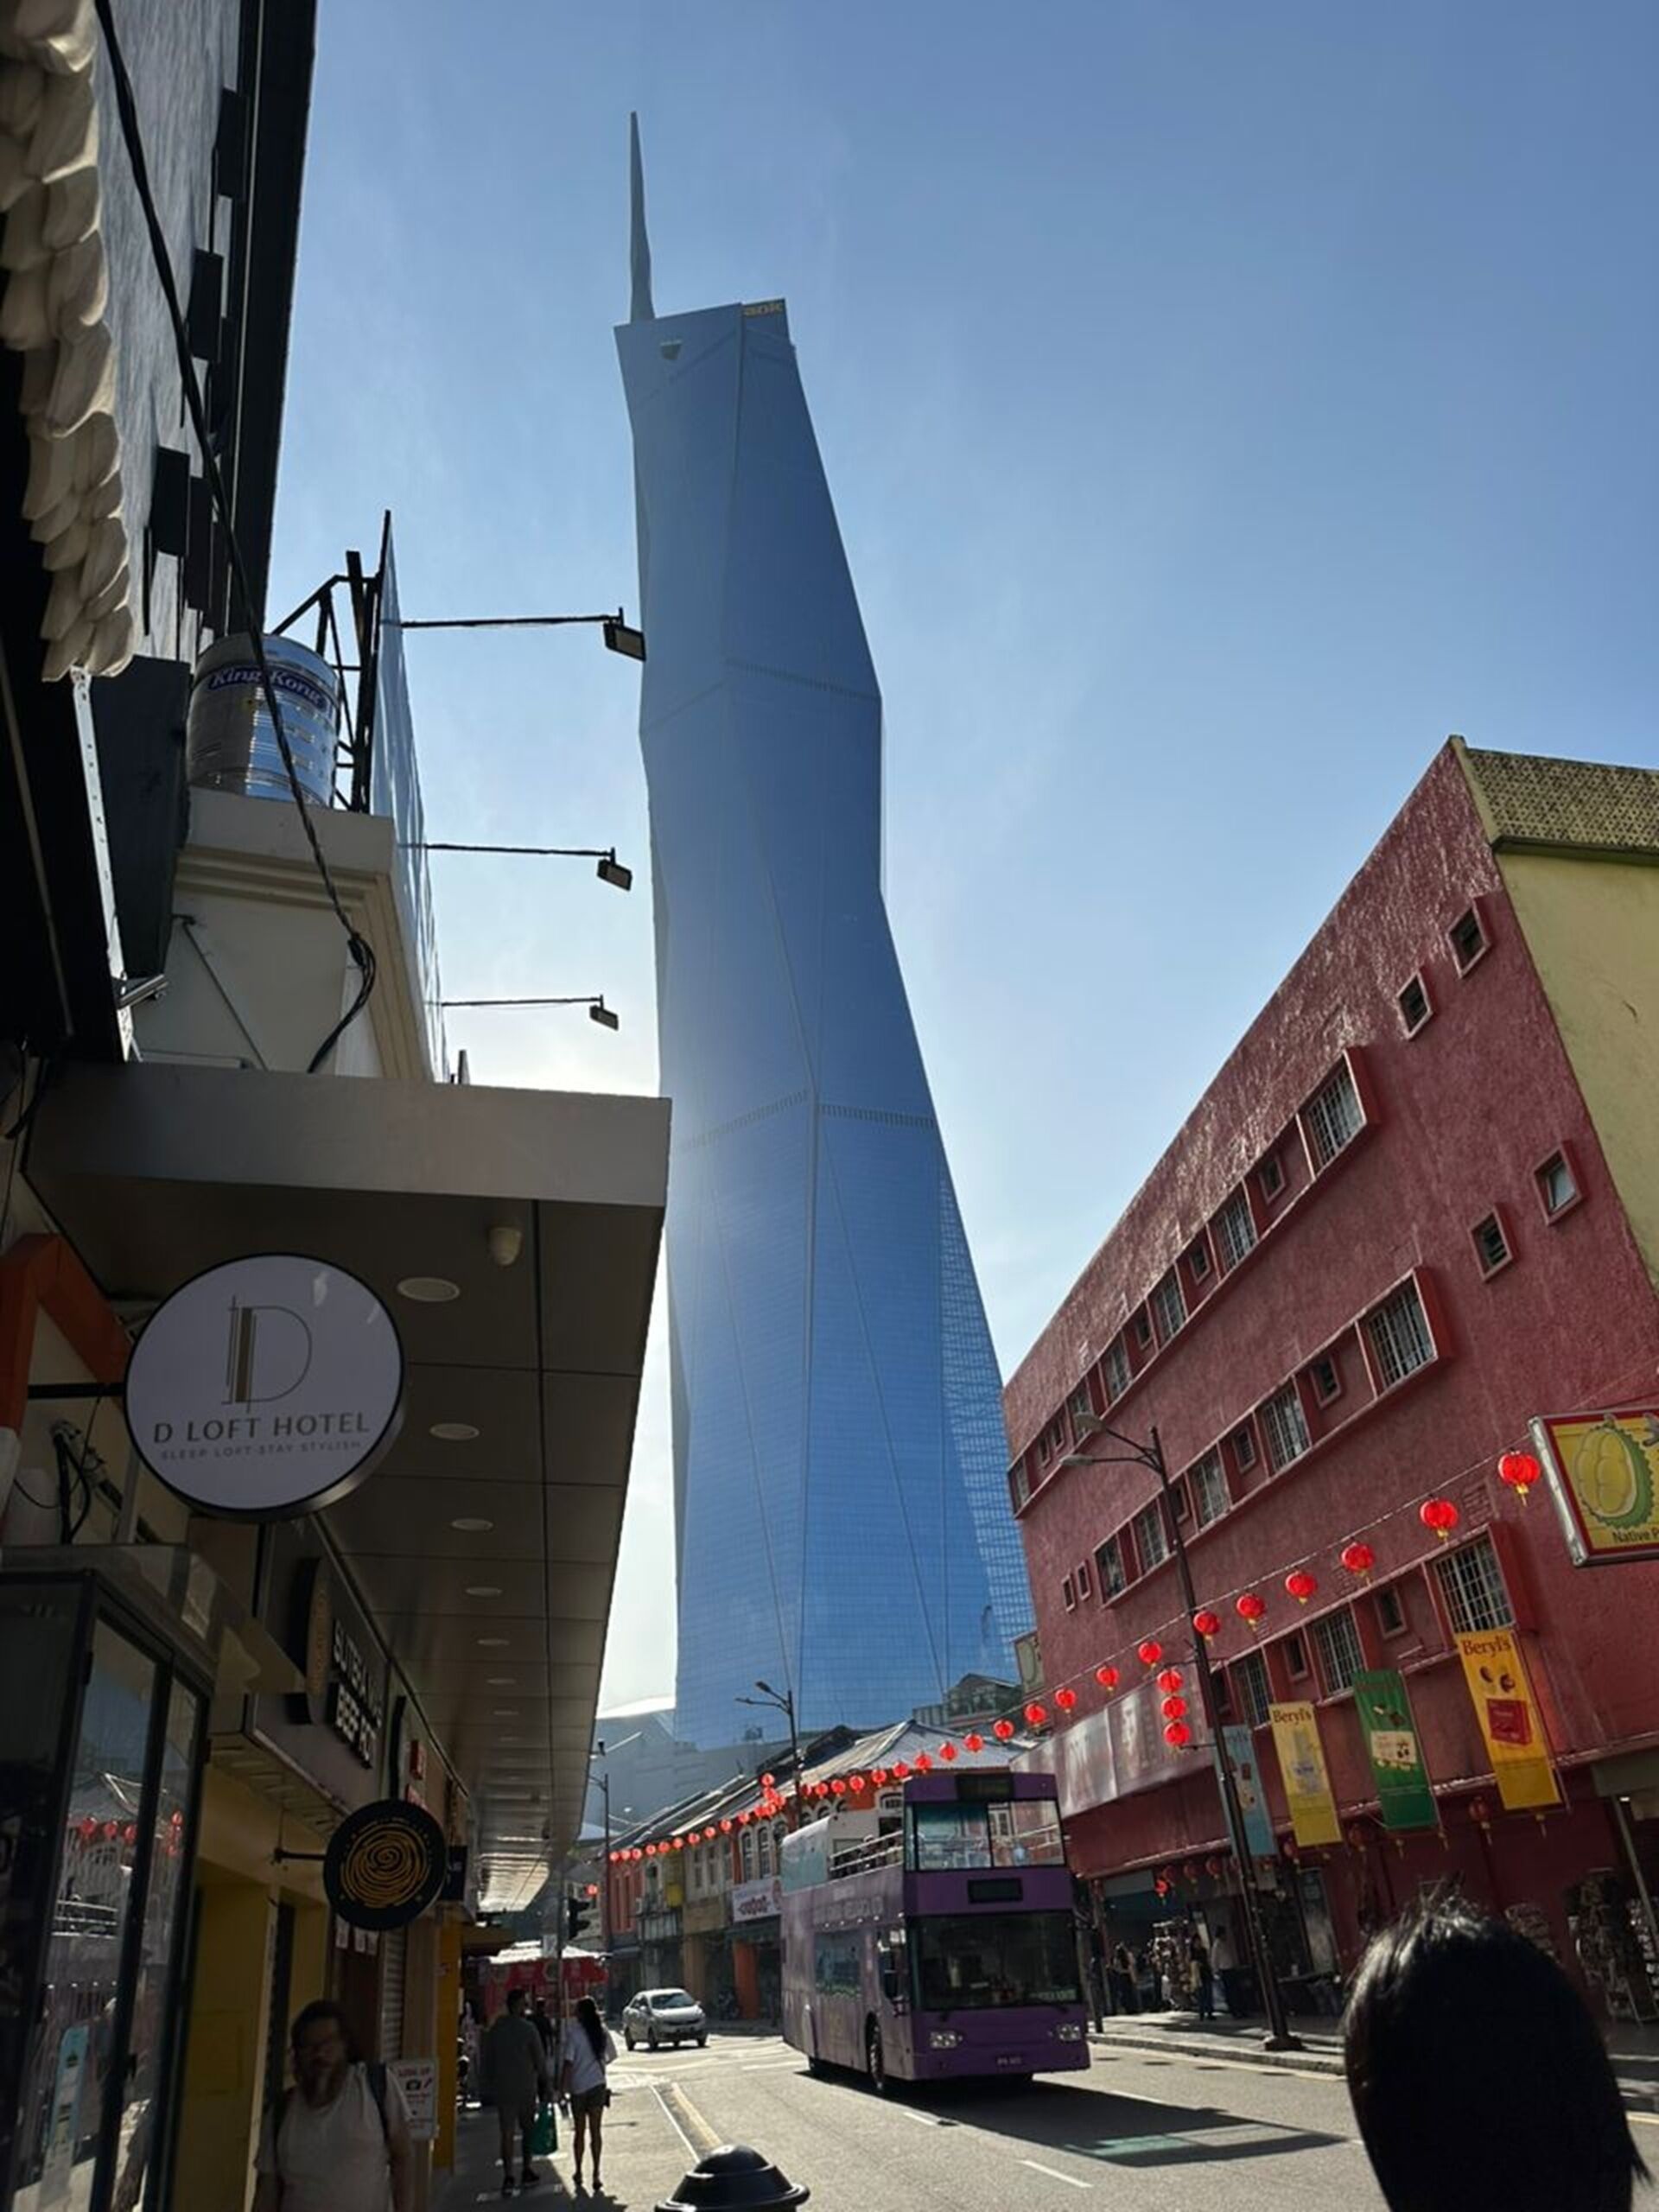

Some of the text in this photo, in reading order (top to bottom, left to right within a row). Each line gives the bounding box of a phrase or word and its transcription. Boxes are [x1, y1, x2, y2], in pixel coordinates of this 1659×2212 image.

[153, 1412, 371, 1443] D LOFT HOTEL
[161, 1440, 361, 1460] SLEEP LOFT STAY STYLISH
[1611, 1529, 1650, 1543] Native
[1461, 1635, 1511, 1659] Beryl's
[1272, 1707, 1313, 1726] Beryl's
